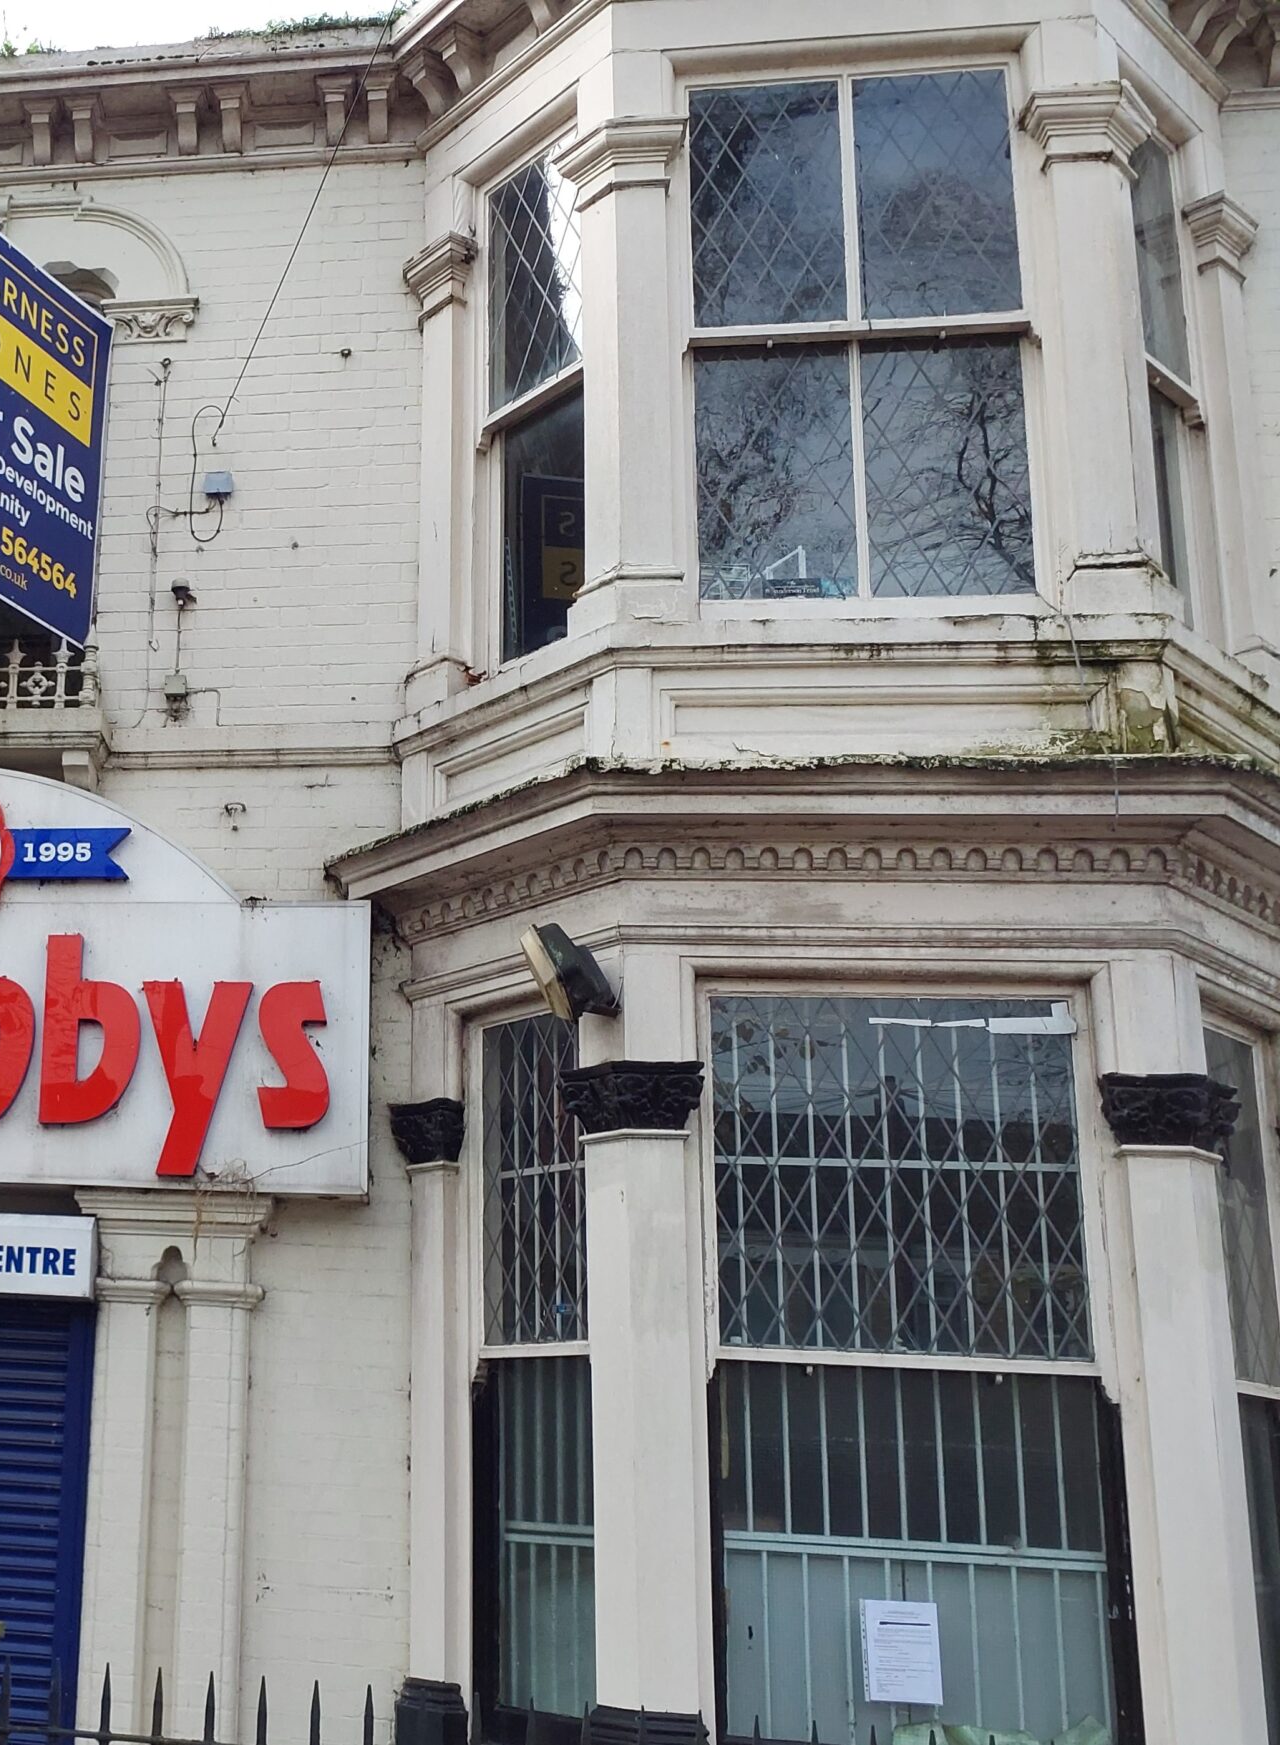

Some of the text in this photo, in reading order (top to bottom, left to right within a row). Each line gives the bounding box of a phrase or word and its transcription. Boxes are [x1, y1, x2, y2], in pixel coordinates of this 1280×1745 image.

[10, 416, 86, 503] Sale
[0, 526, 78, 599] 564564
[22, 842, 92, 863] 1995
